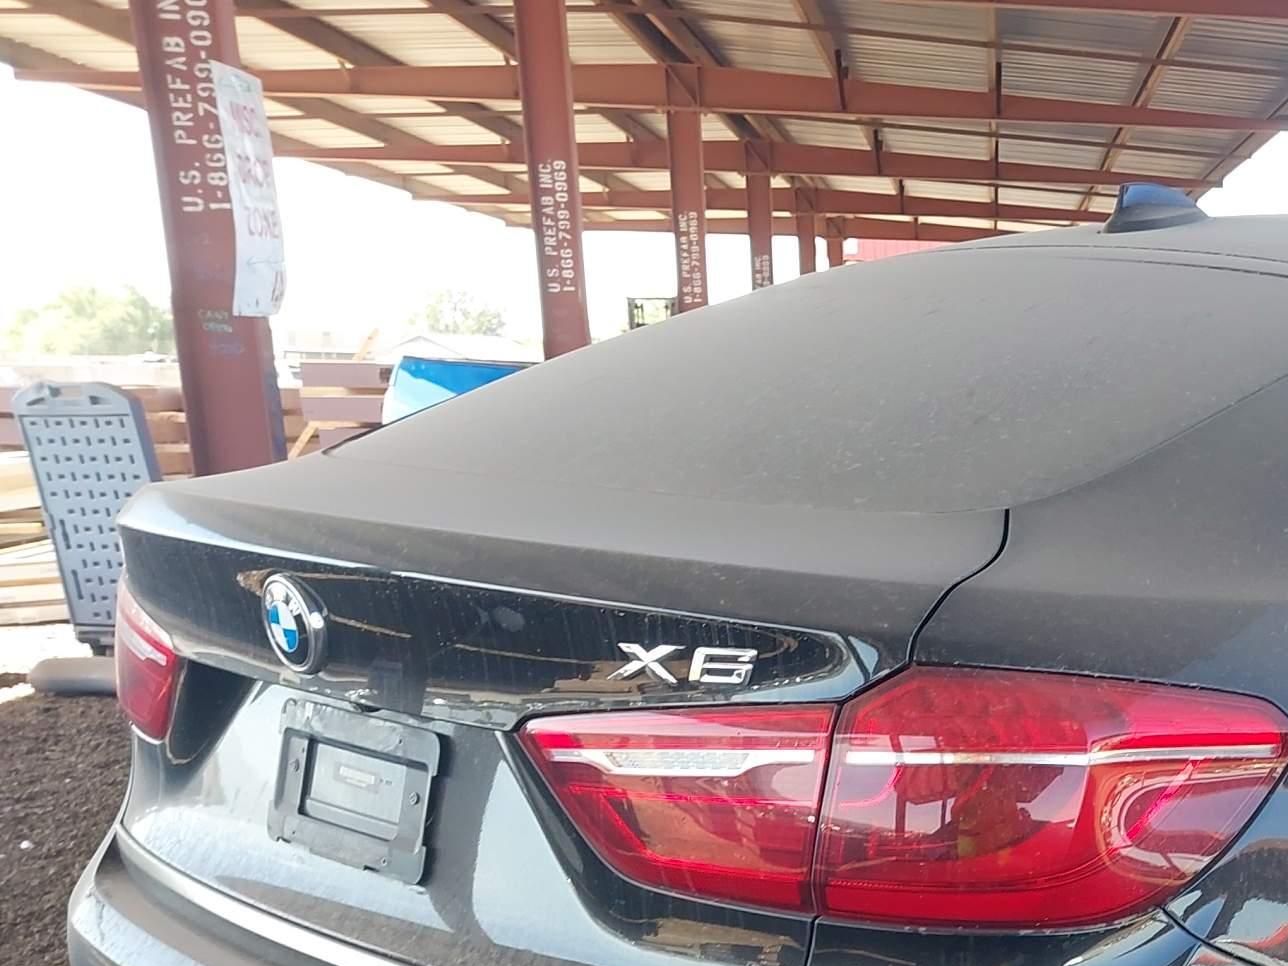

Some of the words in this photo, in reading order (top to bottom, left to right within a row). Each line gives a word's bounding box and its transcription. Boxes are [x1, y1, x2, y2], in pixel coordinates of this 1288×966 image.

[162, 36, 198, 145] PREFAB
[179, 161, 205, 212] U.S.
[538, 159, 553, 188] INC.
[541, 196, 558, 255] PREFAB
[553, 160, 576, 292] 1-866-799-0969
[547, 264, 561, 293] U.S.
[606, 642, 758, 686] X6
